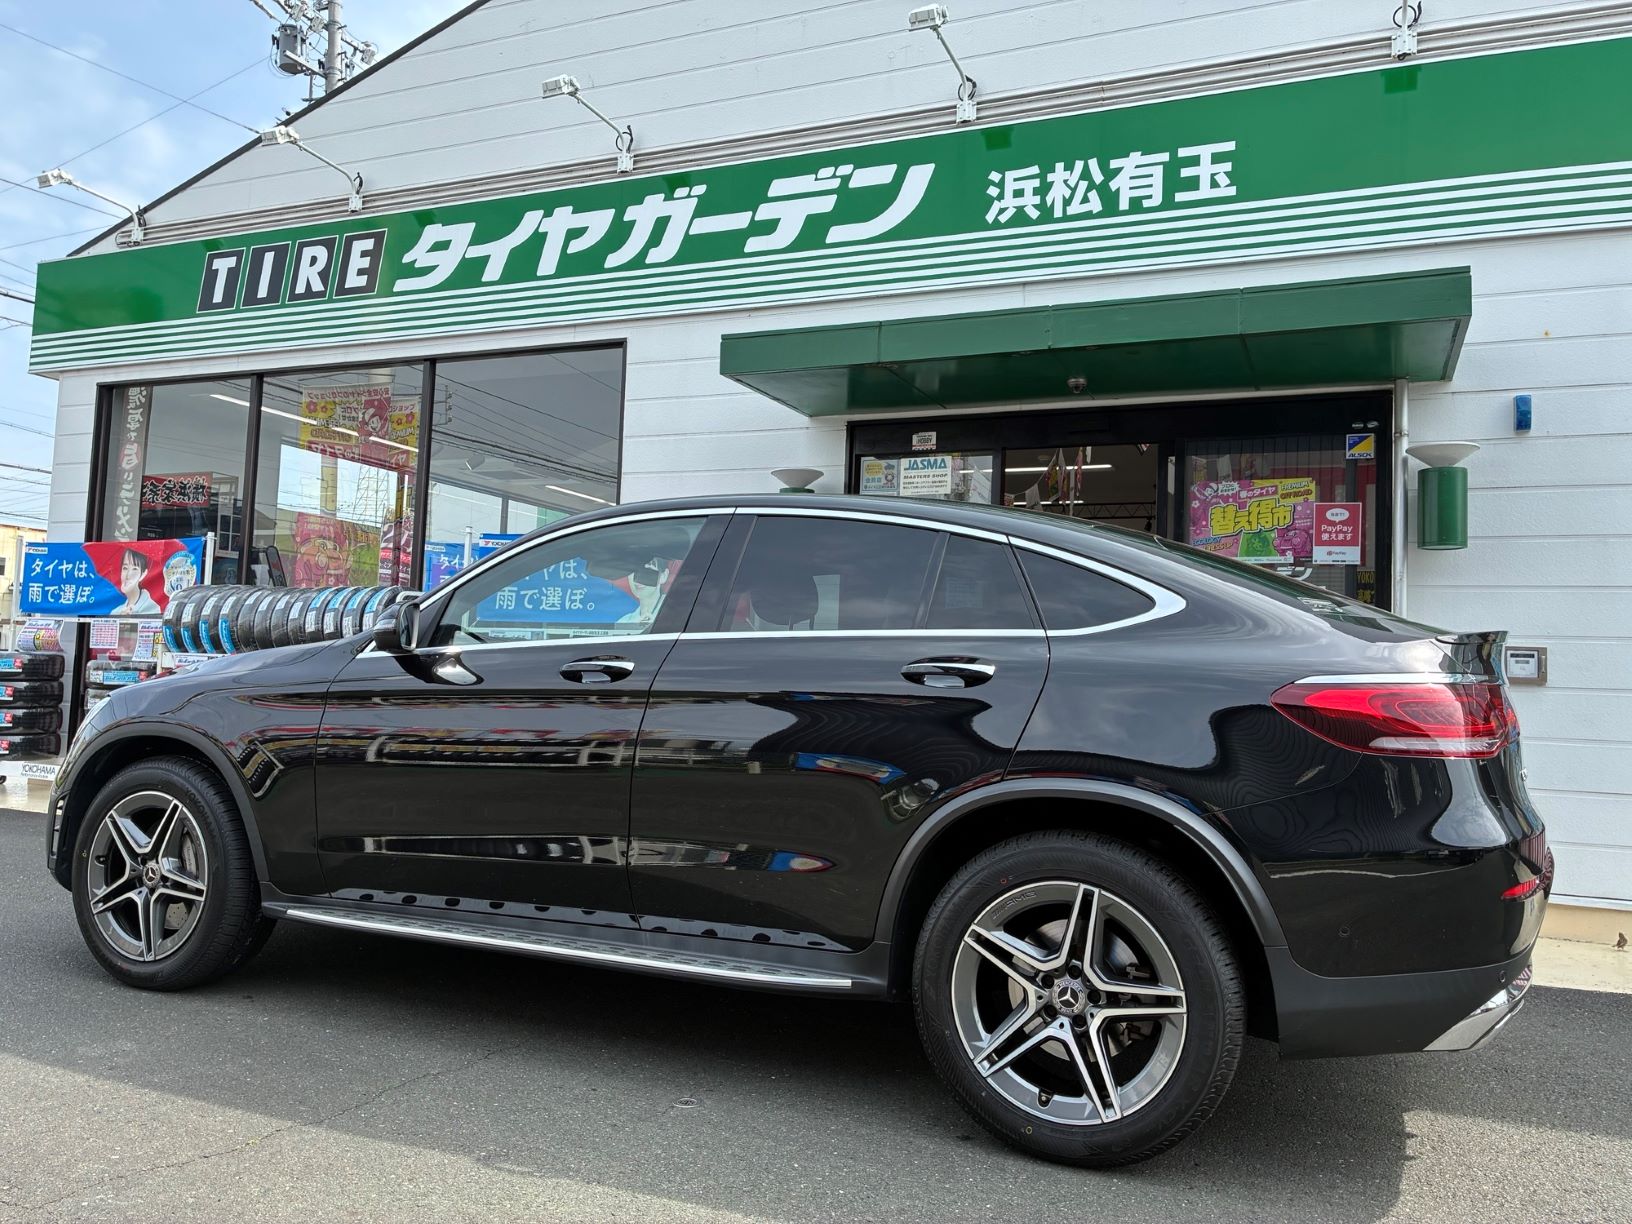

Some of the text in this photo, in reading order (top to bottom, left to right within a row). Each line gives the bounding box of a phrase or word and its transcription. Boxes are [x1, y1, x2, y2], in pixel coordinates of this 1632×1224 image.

[211, 141, 1238, 304] TIRE タイヤガーデン 浜松有玉
[904, 458, 947, 471] JASMA
[1281, 480, 1310, 490] PREMIUM
[1210, 499, 1293, 537] 替え得市
[1321, 524, 1353, 533] PayPay
[1321, 533, 1353, 541] 使えます
[31, 558, 95, 579] タイヤは、
[28, 582, 95, 604] 雨で選ぼ。
[494, 586, 595, 611] 雨で選ぼ。
[22, 763, 56, 776] YOKOHAMA
